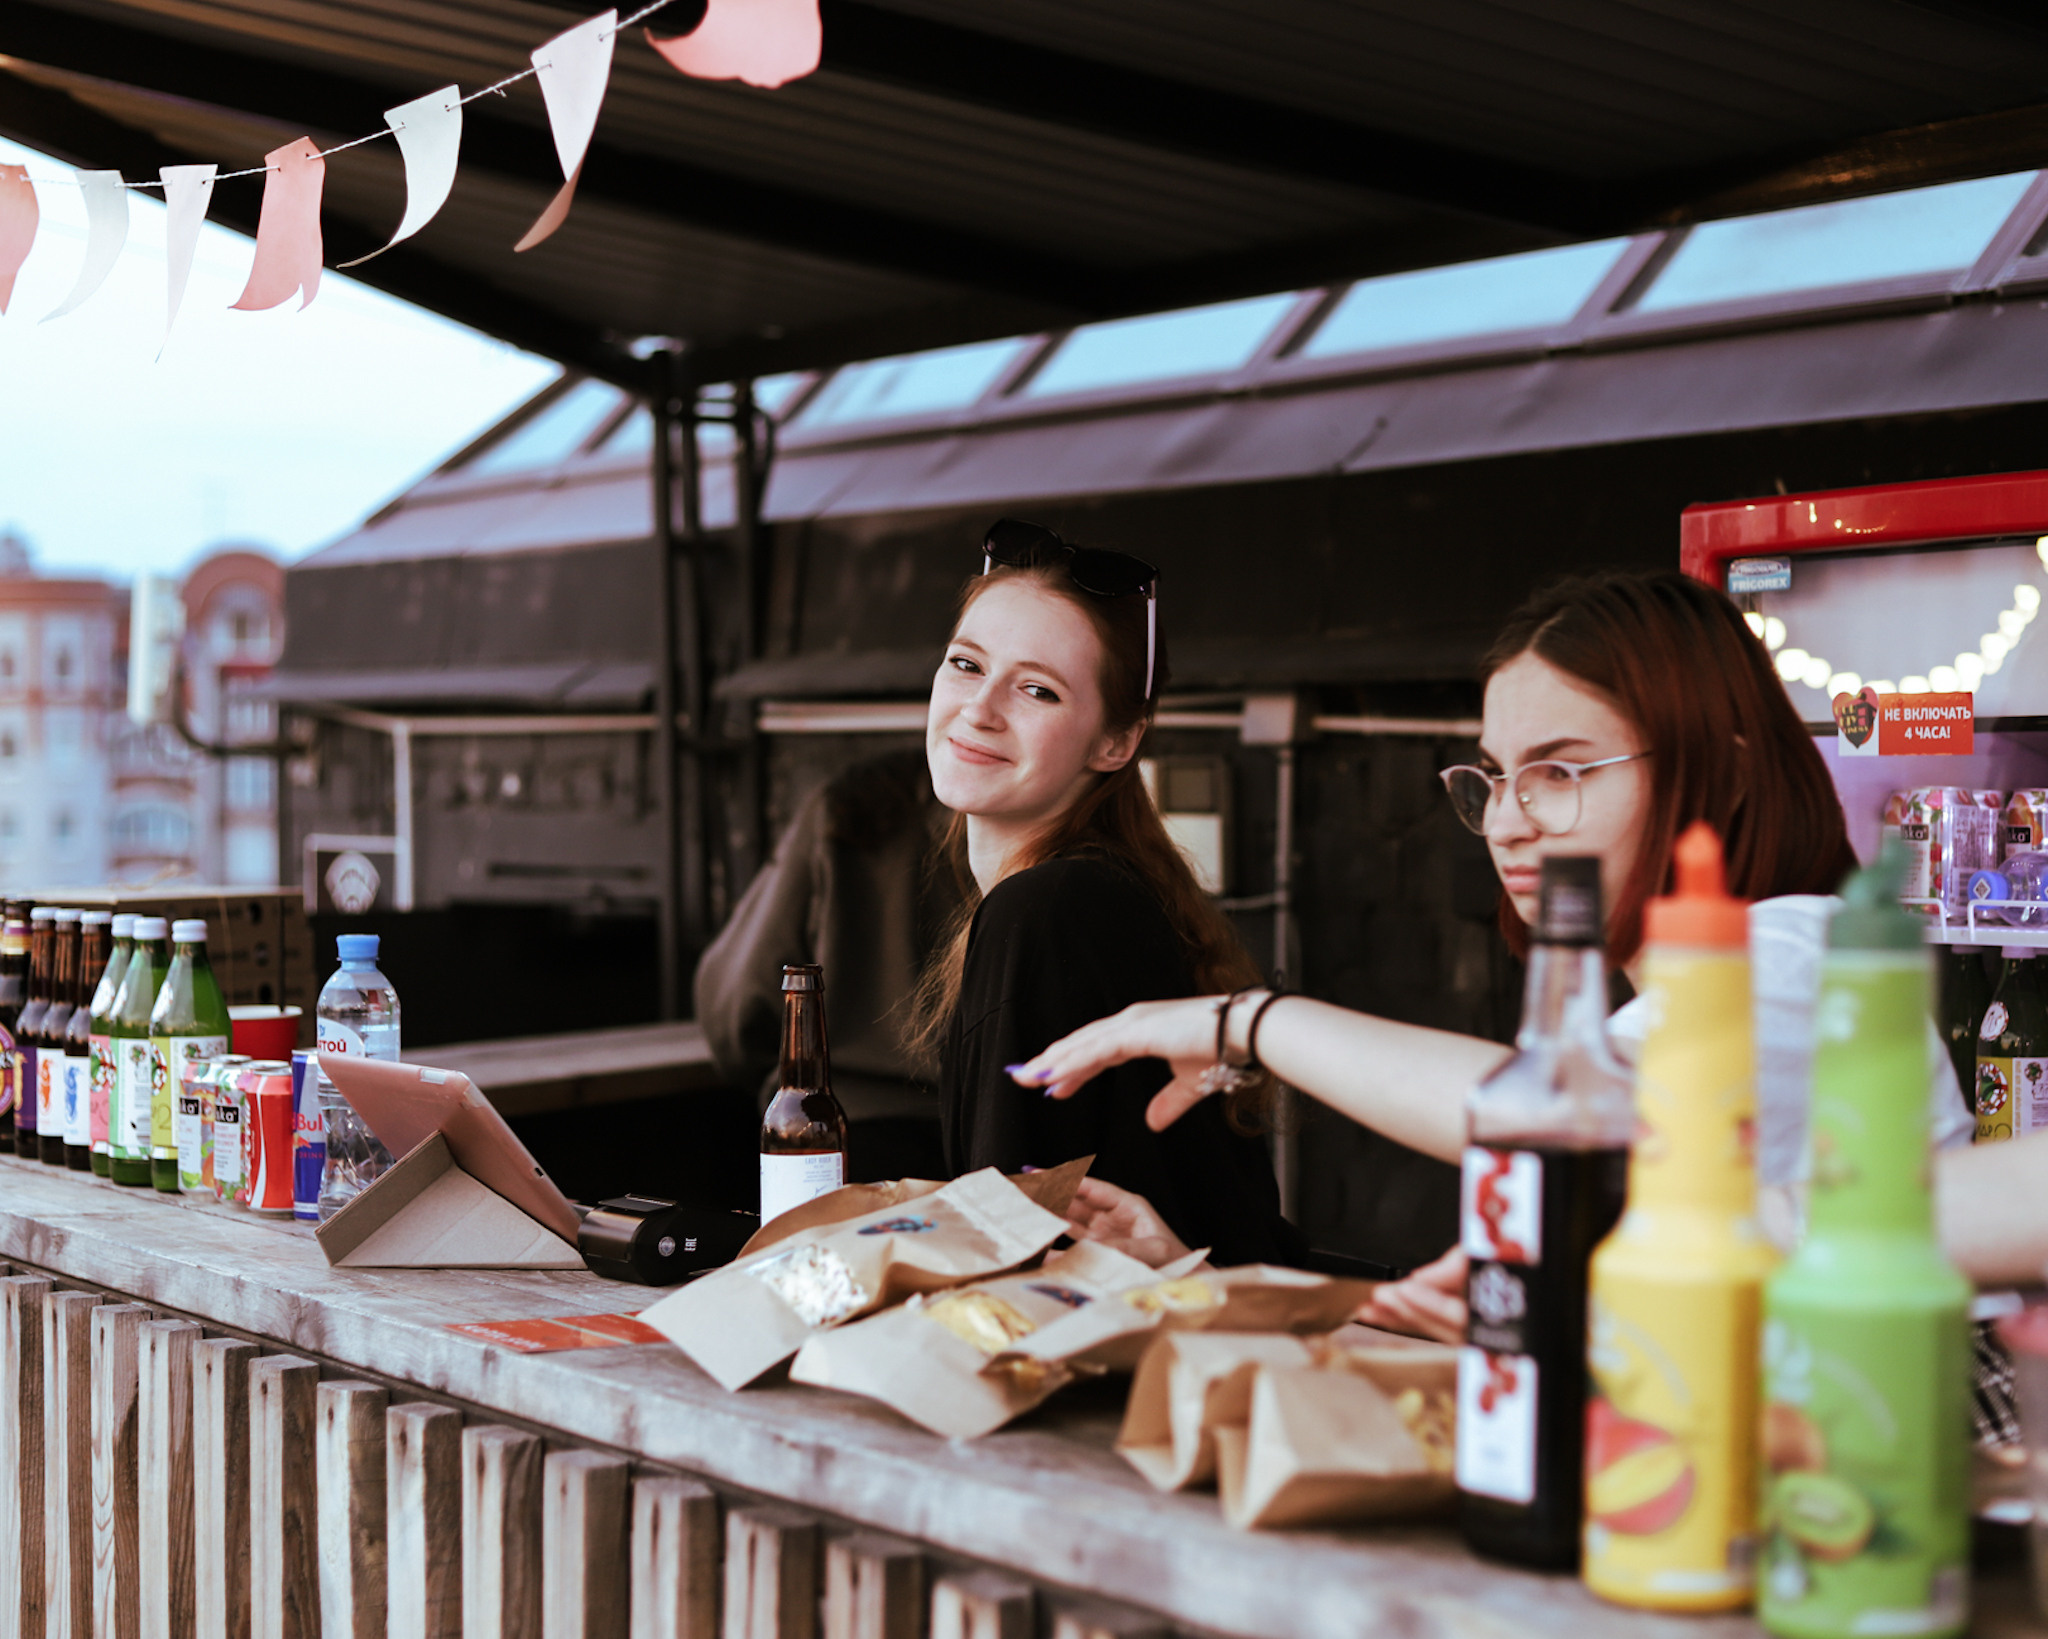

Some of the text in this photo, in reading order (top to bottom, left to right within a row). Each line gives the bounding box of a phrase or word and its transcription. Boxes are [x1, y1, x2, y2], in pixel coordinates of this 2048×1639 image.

[1884, 706, 1972, 721] НЕ ВКЛЮЧАТЬ
[1904, 726, 1951, 740] 4 ЧАСА!
[297, 1113, 323, 1131] Bul
